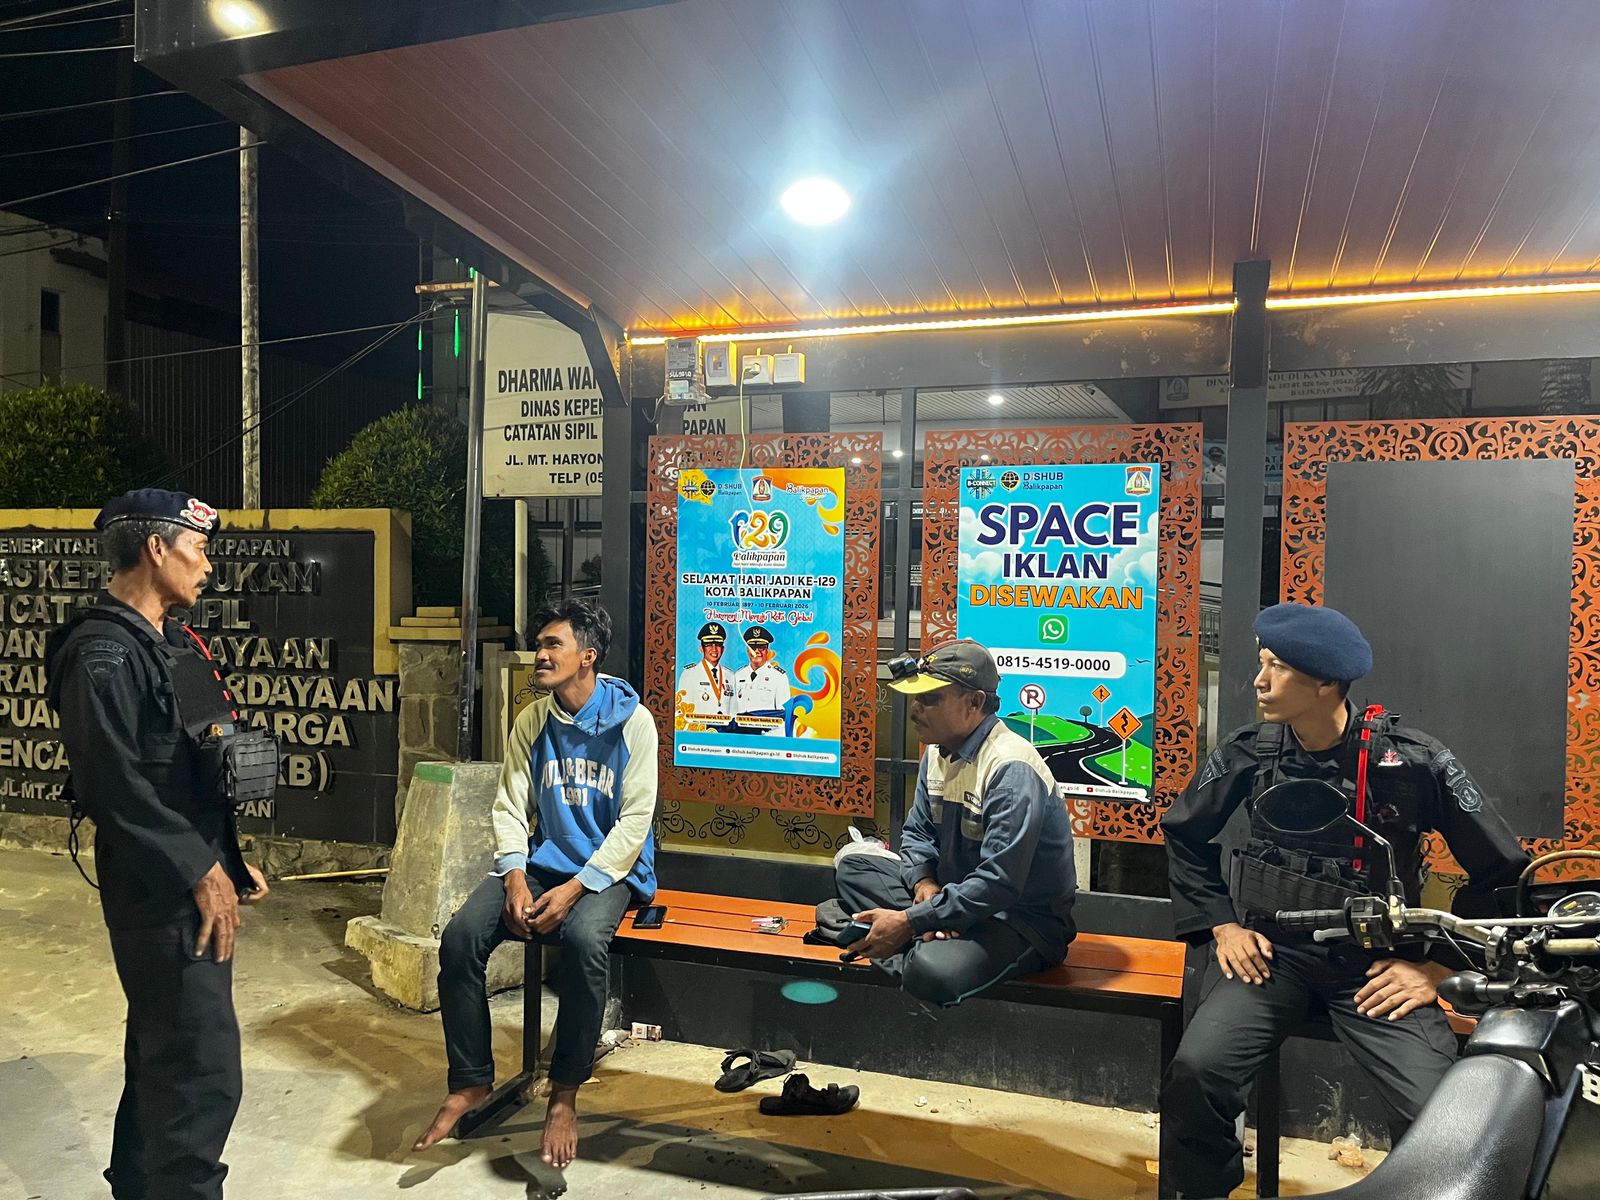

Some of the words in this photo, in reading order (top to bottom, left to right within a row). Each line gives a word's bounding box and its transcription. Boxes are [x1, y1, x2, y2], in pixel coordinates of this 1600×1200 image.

[498, 367, 563, 393] DHARMA
[521, 400, 560, 417] DINAS
[504, 423, 560, 441] CATATAN
[565, 422, 598, 440] SIPIL
[505, 454, 523, 466] JL.
[528, 454, 548, 466] MT.
[549, 472, 580, 484] TELP
[1023, 472, 1064, 481] DISHUB
[787, 483, 829, 494] Balikpapan
[1023, 481, 1063, 491] Balikpapan
[976, 504, 1139, 546] SPACE
[1003, 553, 1108, 579] IKLAN
[683, 574, 735, 585] SELAMAT
[738, 575, 766, 585] HARI
[769, 575, 794, 586] JADI
[798, 576, 836, 587] KE-129
[705, 587, 735, 597] KOTA
[740, 587, 811, 599] BALIKPAPAN
[970, 584, 1143, 609] DISEWAKAN
[10, 594, 97, 624] CAT
[0, 629, 46, 658] AN
[996, 655, 1111, 671] 0815-4519-0000
[240, 711, 350, 746] ARGA
[233, 799, 271, 818] AN
